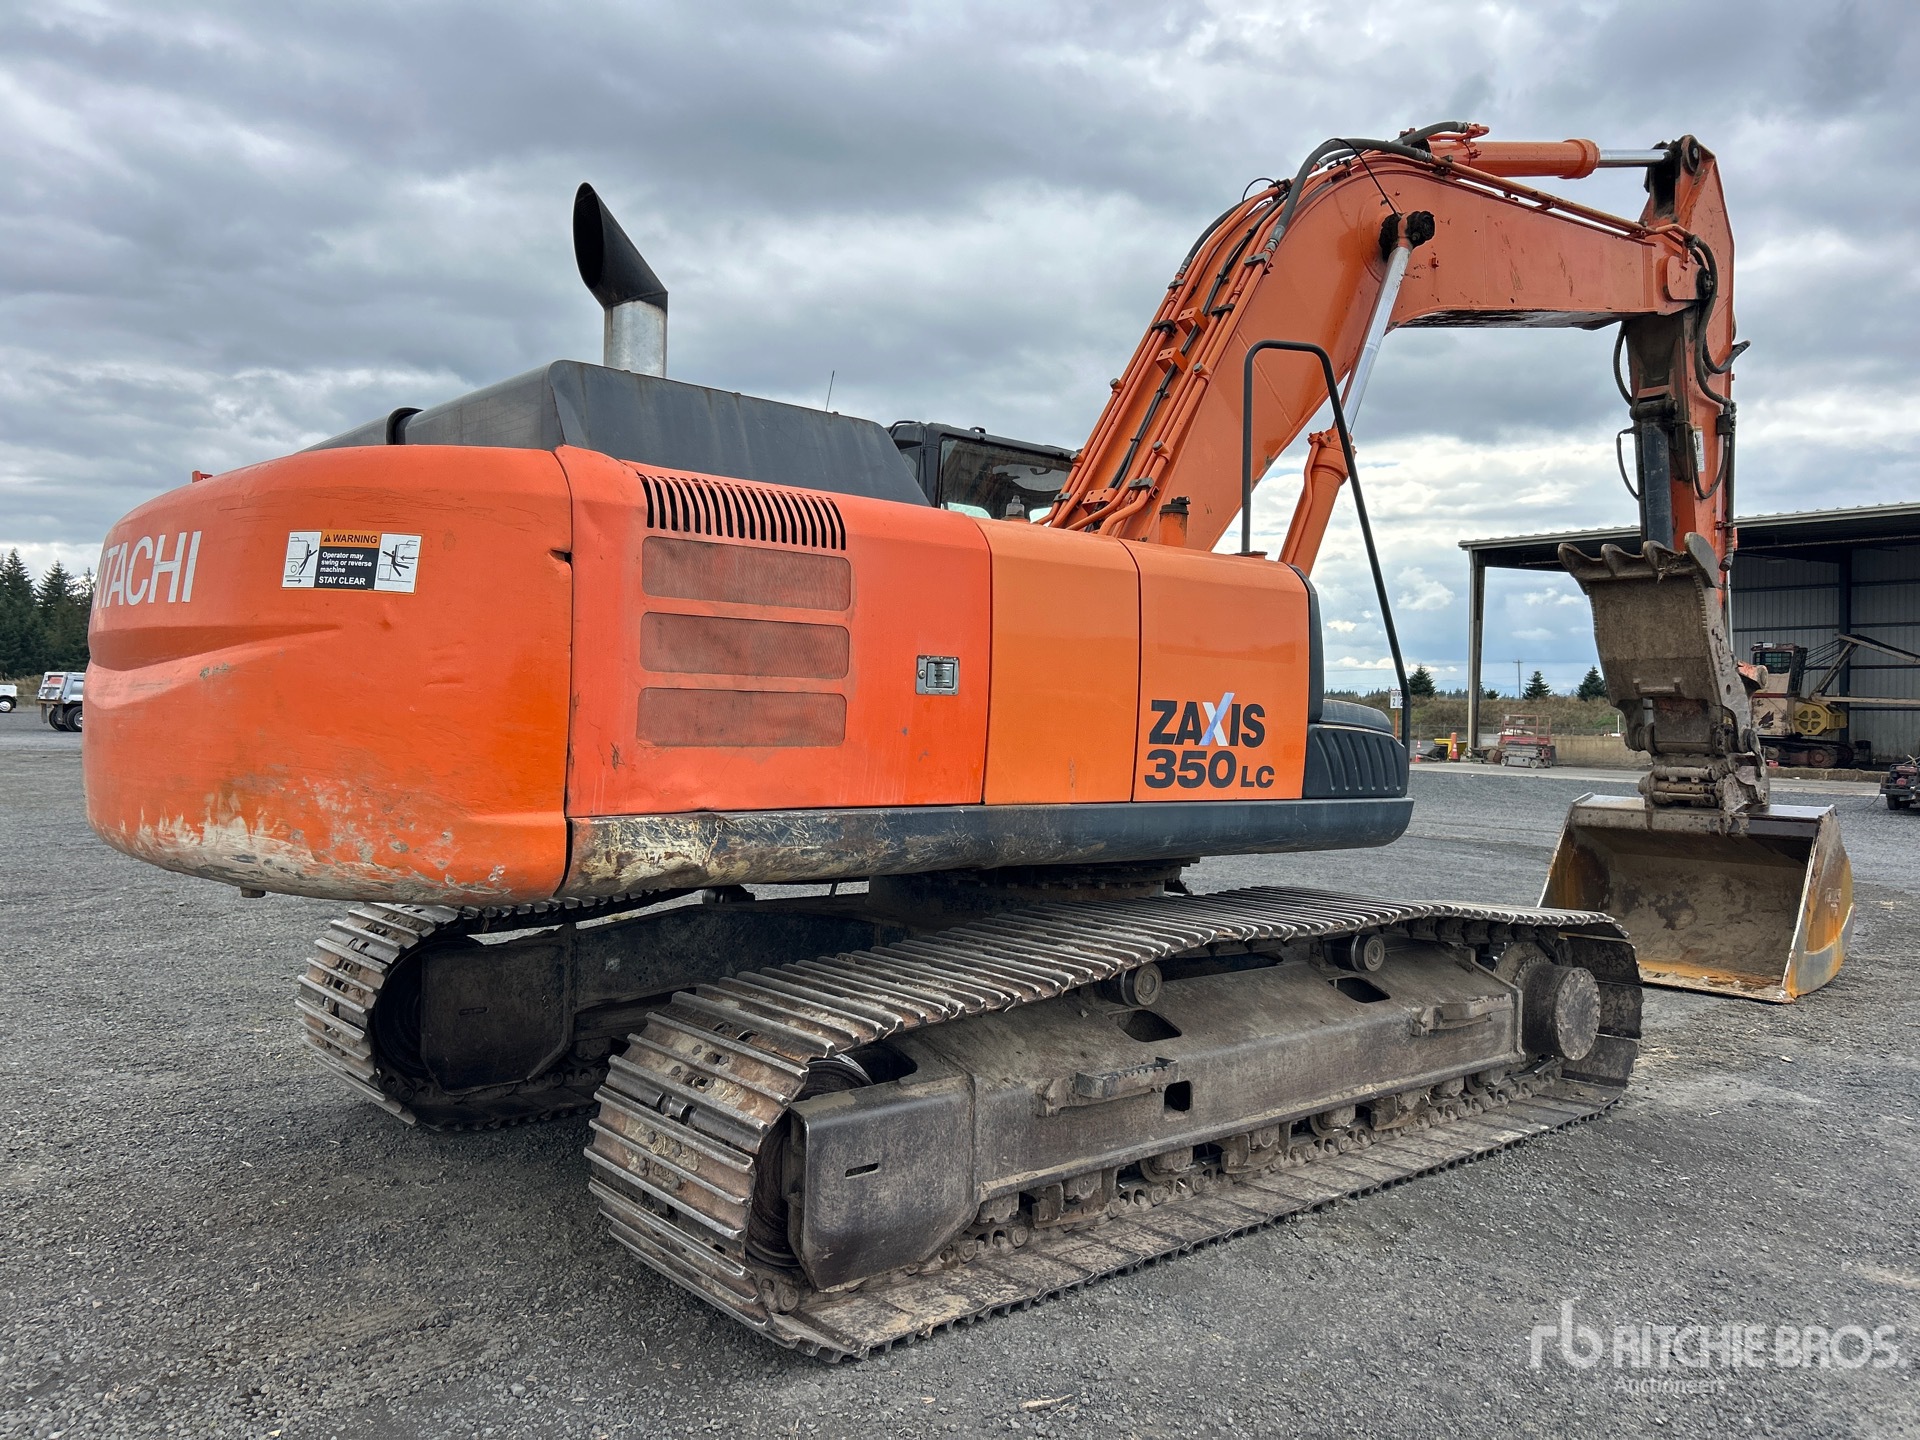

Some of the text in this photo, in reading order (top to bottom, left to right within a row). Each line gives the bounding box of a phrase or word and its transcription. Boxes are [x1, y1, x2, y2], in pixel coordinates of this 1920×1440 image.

[332, 534, 378, 544] WARNING
[322, 551, 364, 561] Operator may
[320, 559, 339, 567] swing
[95, 530, 202, 609] ITACHI
[318, 576, 366, 586] STAY CLEAR
[1148, 692, 1266, 748] ZAXIS
[1144, 749, 1275, 789] 350 LC
